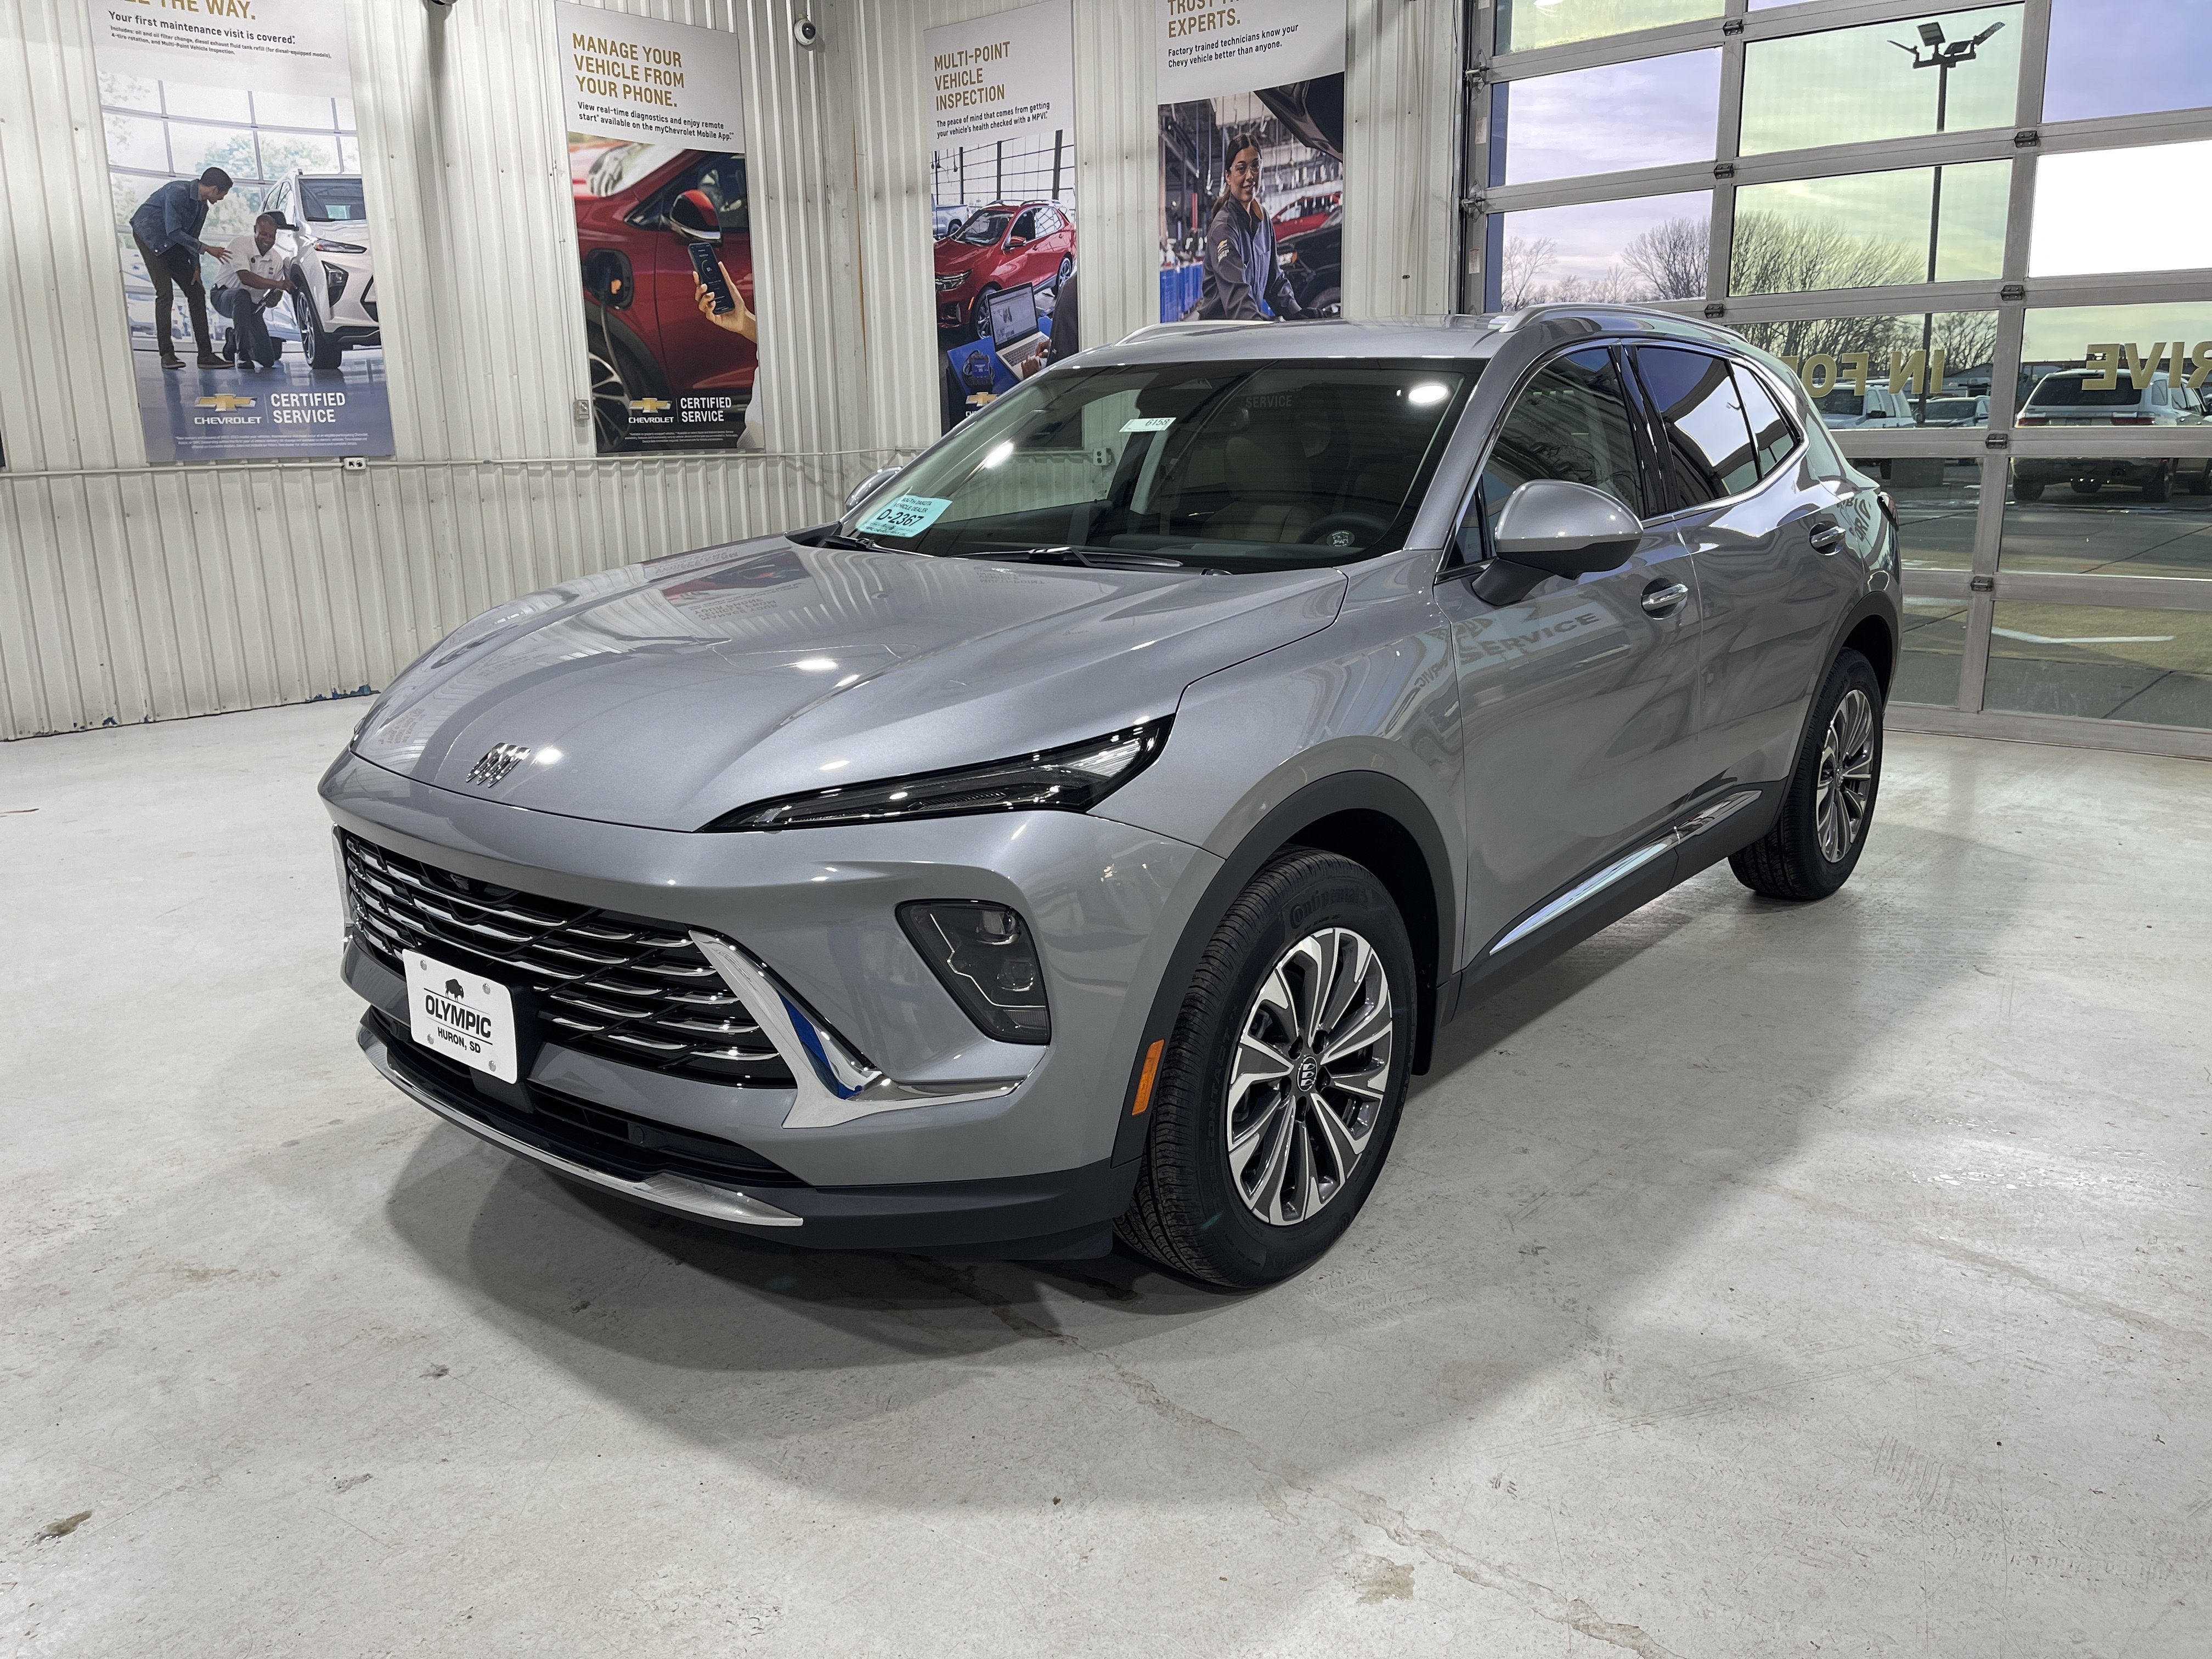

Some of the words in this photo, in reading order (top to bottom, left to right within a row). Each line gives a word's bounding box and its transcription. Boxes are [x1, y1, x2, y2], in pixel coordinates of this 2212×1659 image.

[206, 0, 256, 20] WAY.
[109, 10, 132, 22] Your
[135, 15, 157, 27] first
[160, 20, 222, 36] maintenance
[224, 28, 244, 39] visit
[246, 30, 254, 40] is
[110, 25, 134, 35] Includes:
[1168, 8, 1240, 38] EXPERTS.
[128, 36, 150, 44] rotation,
[161, 41, 189, 49] Multi-Point
[208, 47, 236, 55] Inspection.
[572, 33, 639, 60] MANAGE
[642, 46, 682, 67] YOUR
[1168, 46, 1194, 57] Factory
[1194, 40, 1219, 52] trained
[1220, 32, 1260, 47] technicians
[1261, 29, 1280, 39] know
[1282, 24, 1299, 36] your
[934, 41, 1011, 71] MULTI-POINT
[1168, 58, 1188, 68] Chevy
[1189, 54, 1213, 65] vehicle
[1214, 49, 1236, 60] better
[1238, 46, 1253, 56] than
[1255, 41, 1283, 53] anyone.
[574, 54, 640, 82] VEHICLE
[644, 67, 685, 88] FROM
[934, 67, 983, 91] VEHICLE
[575, 75, 618, 98] YOUR
[623, 83, 678, 108] PHONE.
[936, 83, 1005, 111] INSPECTION
[578, 101, 595, 111] View
[596, 105, 629, 117] real-time
[630, 110, 668, 123] diagnostics
[670, 115, 681, 125] and
[683, 118, 701, 130] enjoy
[702, 121, 724, 130] remote
[936, 119, 946, 128] The
[947, 117, 962, 127] peace
[963, 115, 969, 123] of
[969, 112, 983, 122] mind
[984, 111, 995, 120] that
[996, 109, 1014, 117] comes
[1015, 106, 1029, 115] from
[1029, 101, 1050, 112] getting
[600, 116, 630, 128] available
[642, 122, 653, 131] the
[654, 126, 695, 137] myChevrolet
[697, 129, 716, 139] Mobile
[936, 130, 949, 139] your
[949, 125, 972, 136] vehicle's
[972, 122, 989, 132] health
[990, 118, 1012, 129] checked
[1013, 116, 1026, 125] with
[271, 392, 346, 408] CERTIFIED
[680, 397, 732, 409] CERTIFIED
[194, 416, 262, 425] CHEVROLET
[273, 409, 336, 424] SERVICE
[681, 410, 724, 422] SERVICE
[1146, 419, 1170, 427] 6158
[877, 509, 925, 527] D-2367
[426, 995, 492, 1038] OLYMPIC
[438, 1027, 467, 1051] HURON,
[470, 1041, 481, 1054] SD
